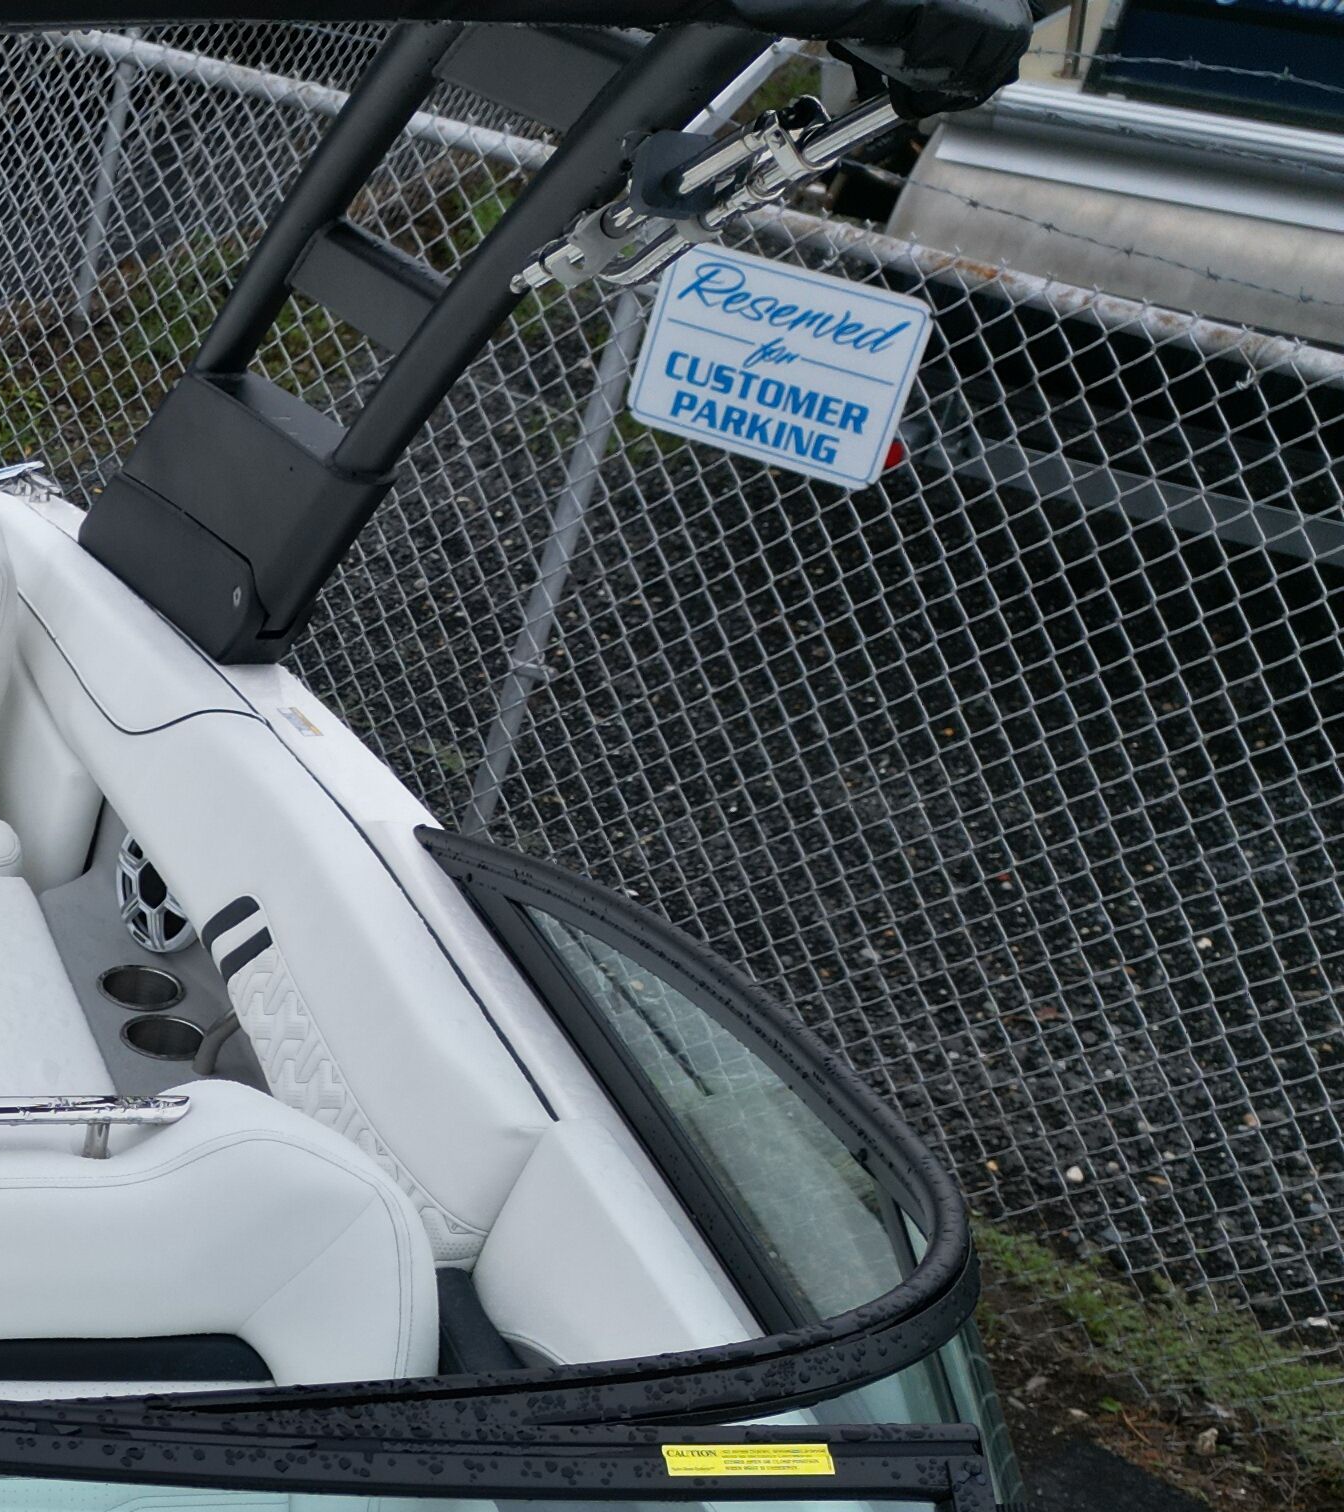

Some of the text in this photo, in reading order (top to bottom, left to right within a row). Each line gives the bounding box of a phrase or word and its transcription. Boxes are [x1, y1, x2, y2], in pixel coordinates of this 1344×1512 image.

[678, 262, 911, 353] Reserved
[743, 337, 799, 369] for
[665, 351, 869, 434] CUSTOMER
[670, 391, 839, 465] PARKING
[666, 1449, 717, 1458] CAUTION
